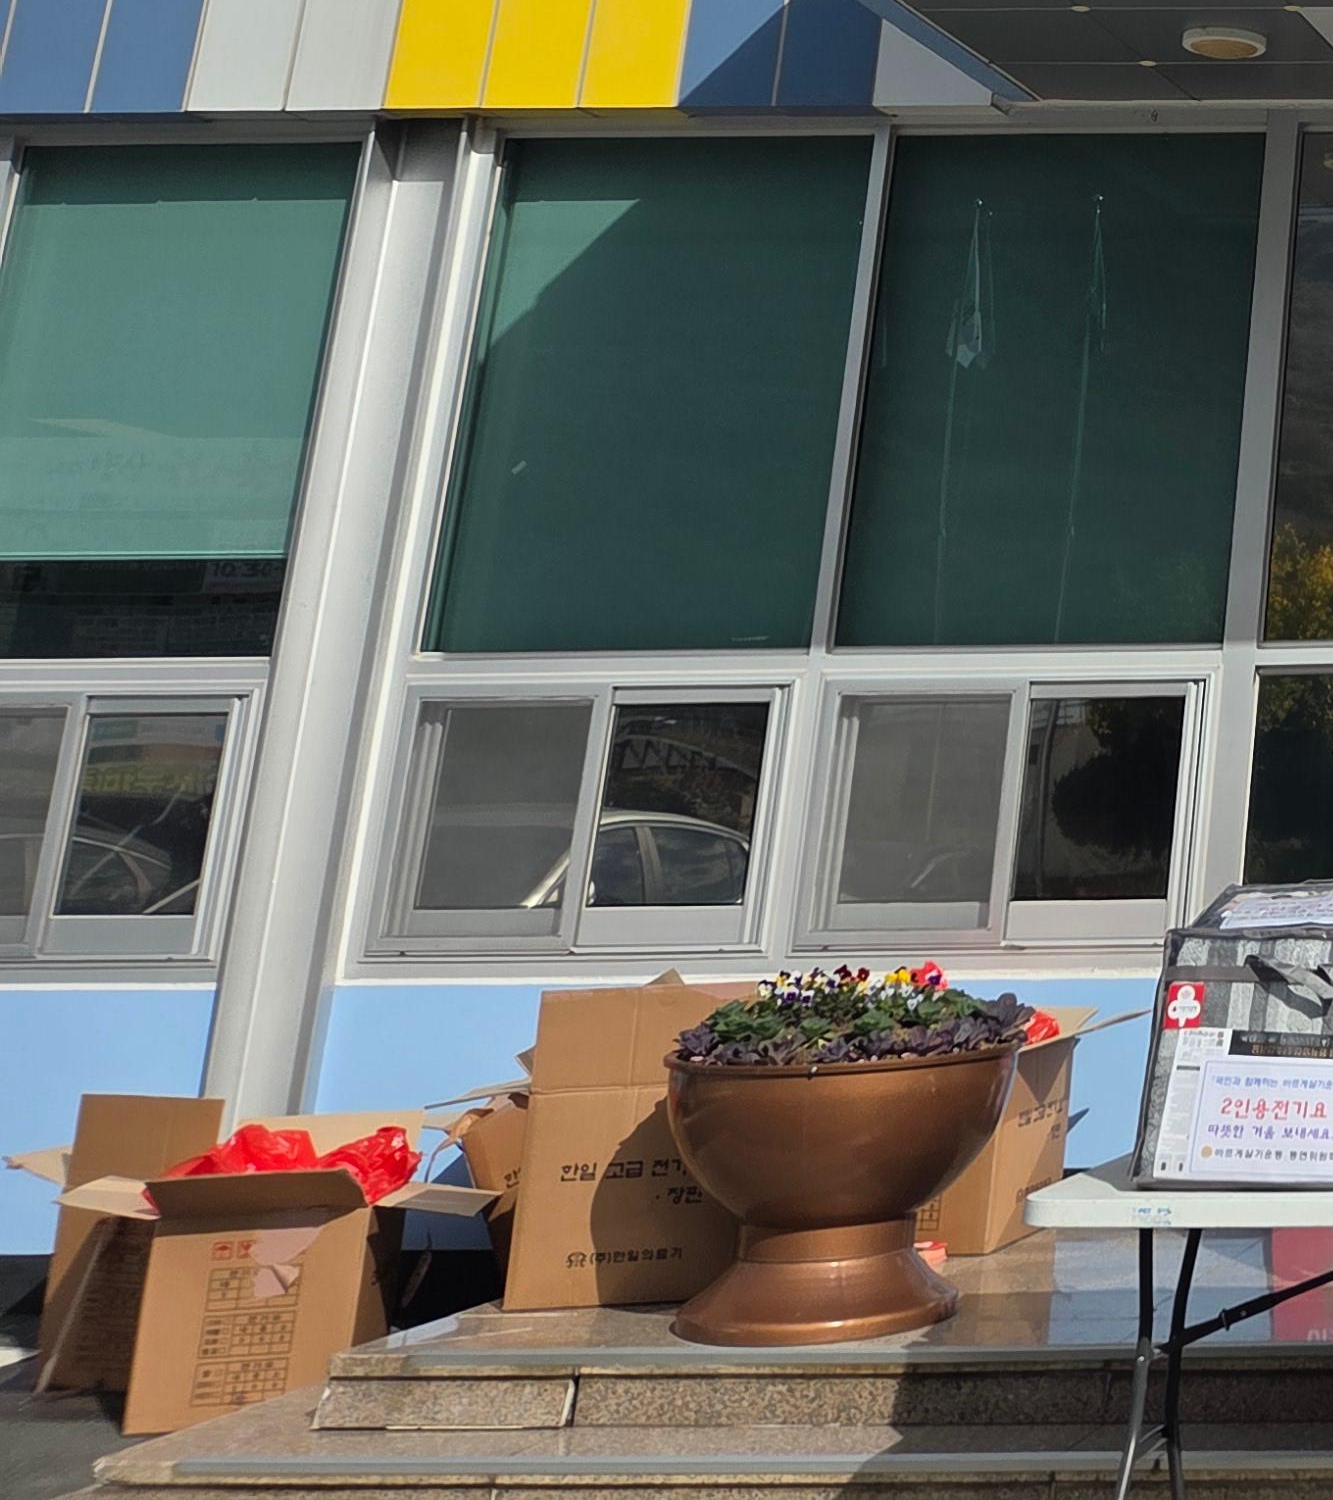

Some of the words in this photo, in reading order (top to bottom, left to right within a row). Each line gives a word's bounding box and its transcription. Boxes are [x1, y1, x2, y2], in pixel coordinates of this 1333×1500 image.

[1219, 1097, 1328, 1121] 2인용전기요
[560, 1162, 598, 1182] 한일
[605, 1160, 644, 1180] 고급
